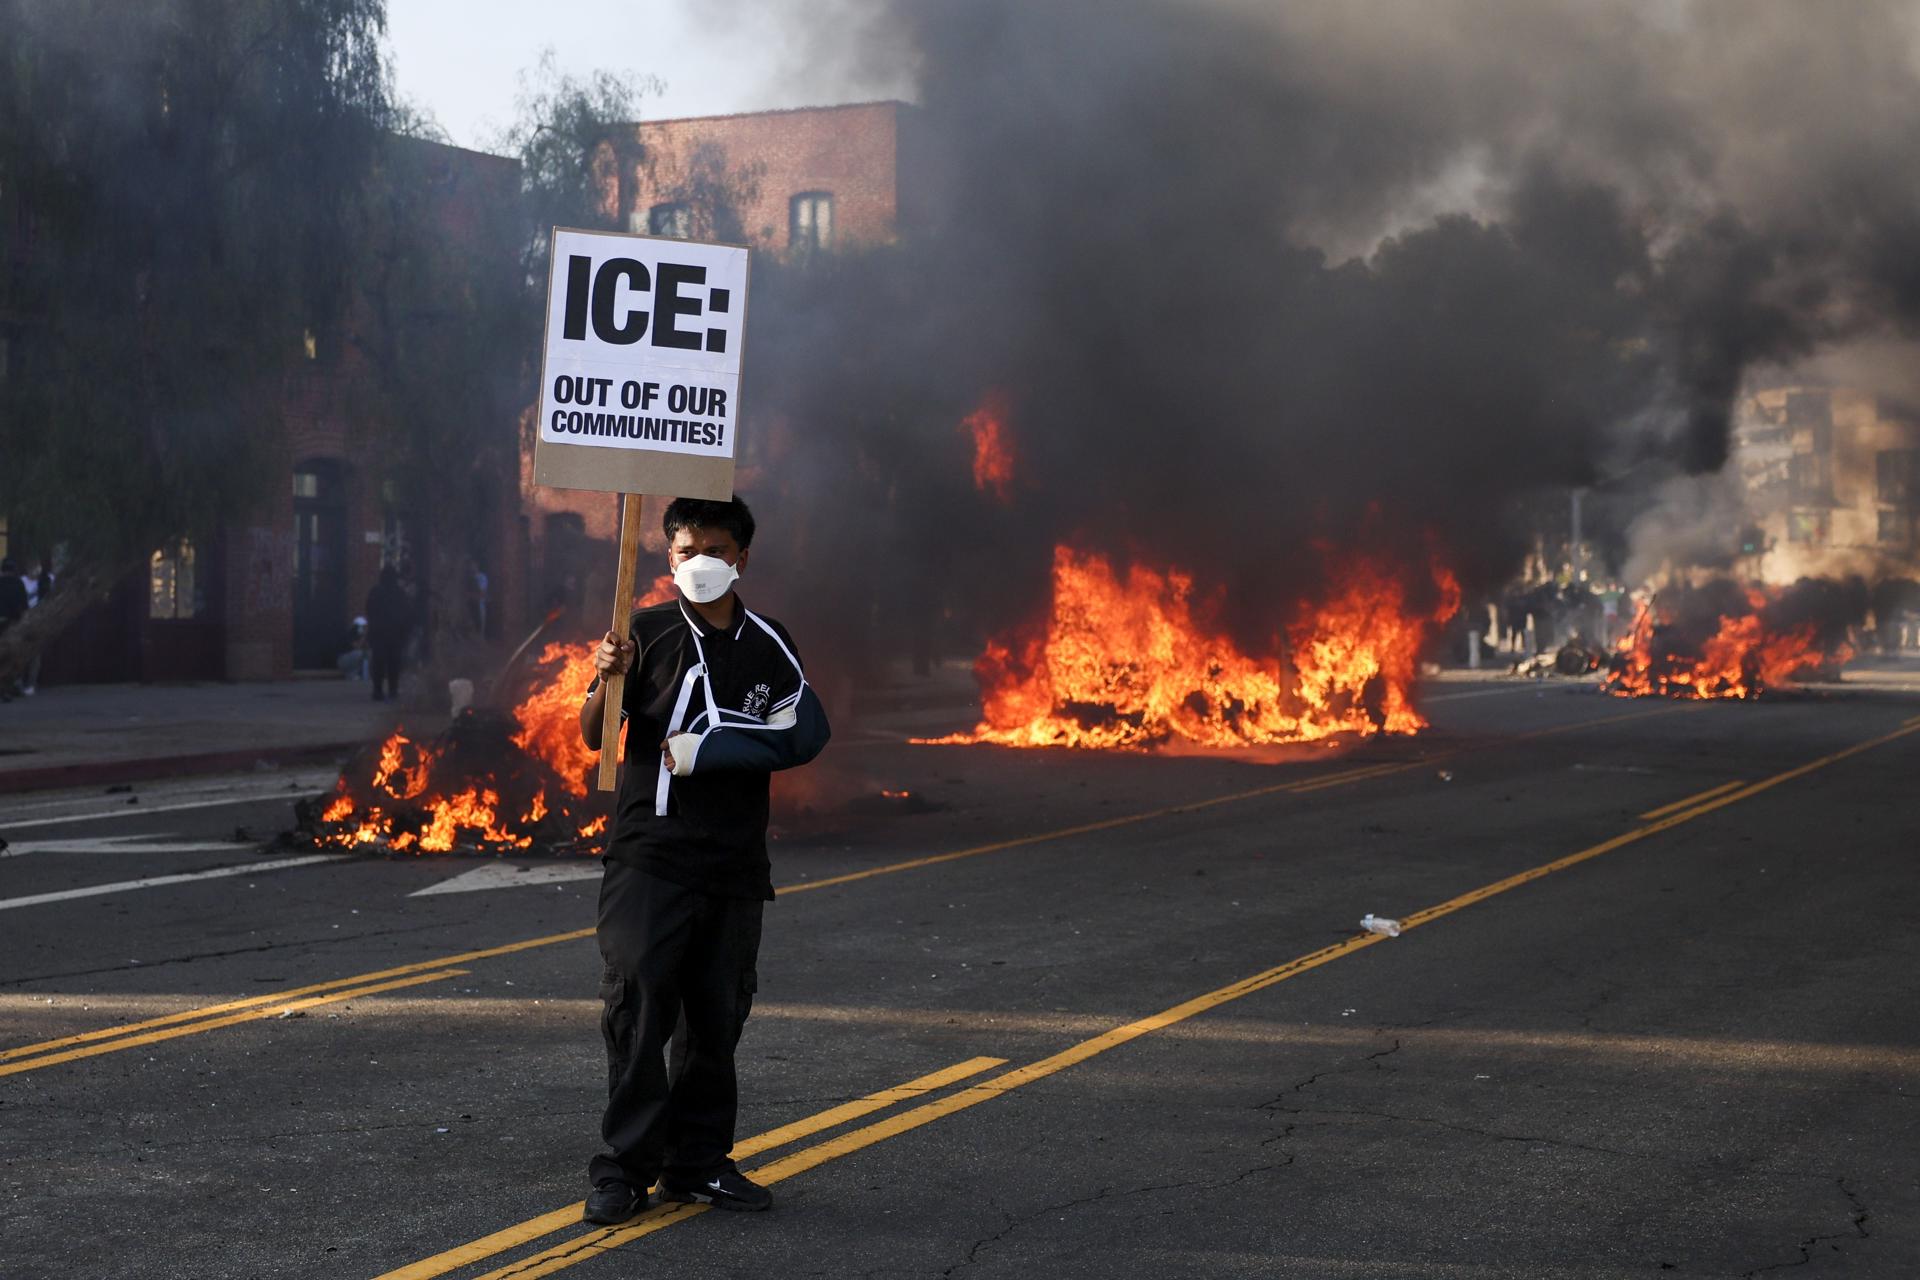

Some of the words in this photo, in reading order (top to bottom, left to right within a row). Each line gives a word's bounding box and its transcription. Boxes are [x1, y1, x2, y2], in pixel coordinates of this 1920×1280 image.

[563, 254, 730, 353] ICE:
[554, 375, 613, 407] OUT
[620, 380, 660, 410] OF
[667, 384, 727, 418] OUR
[551, 410, 724, 446] COMMUNITIES!
